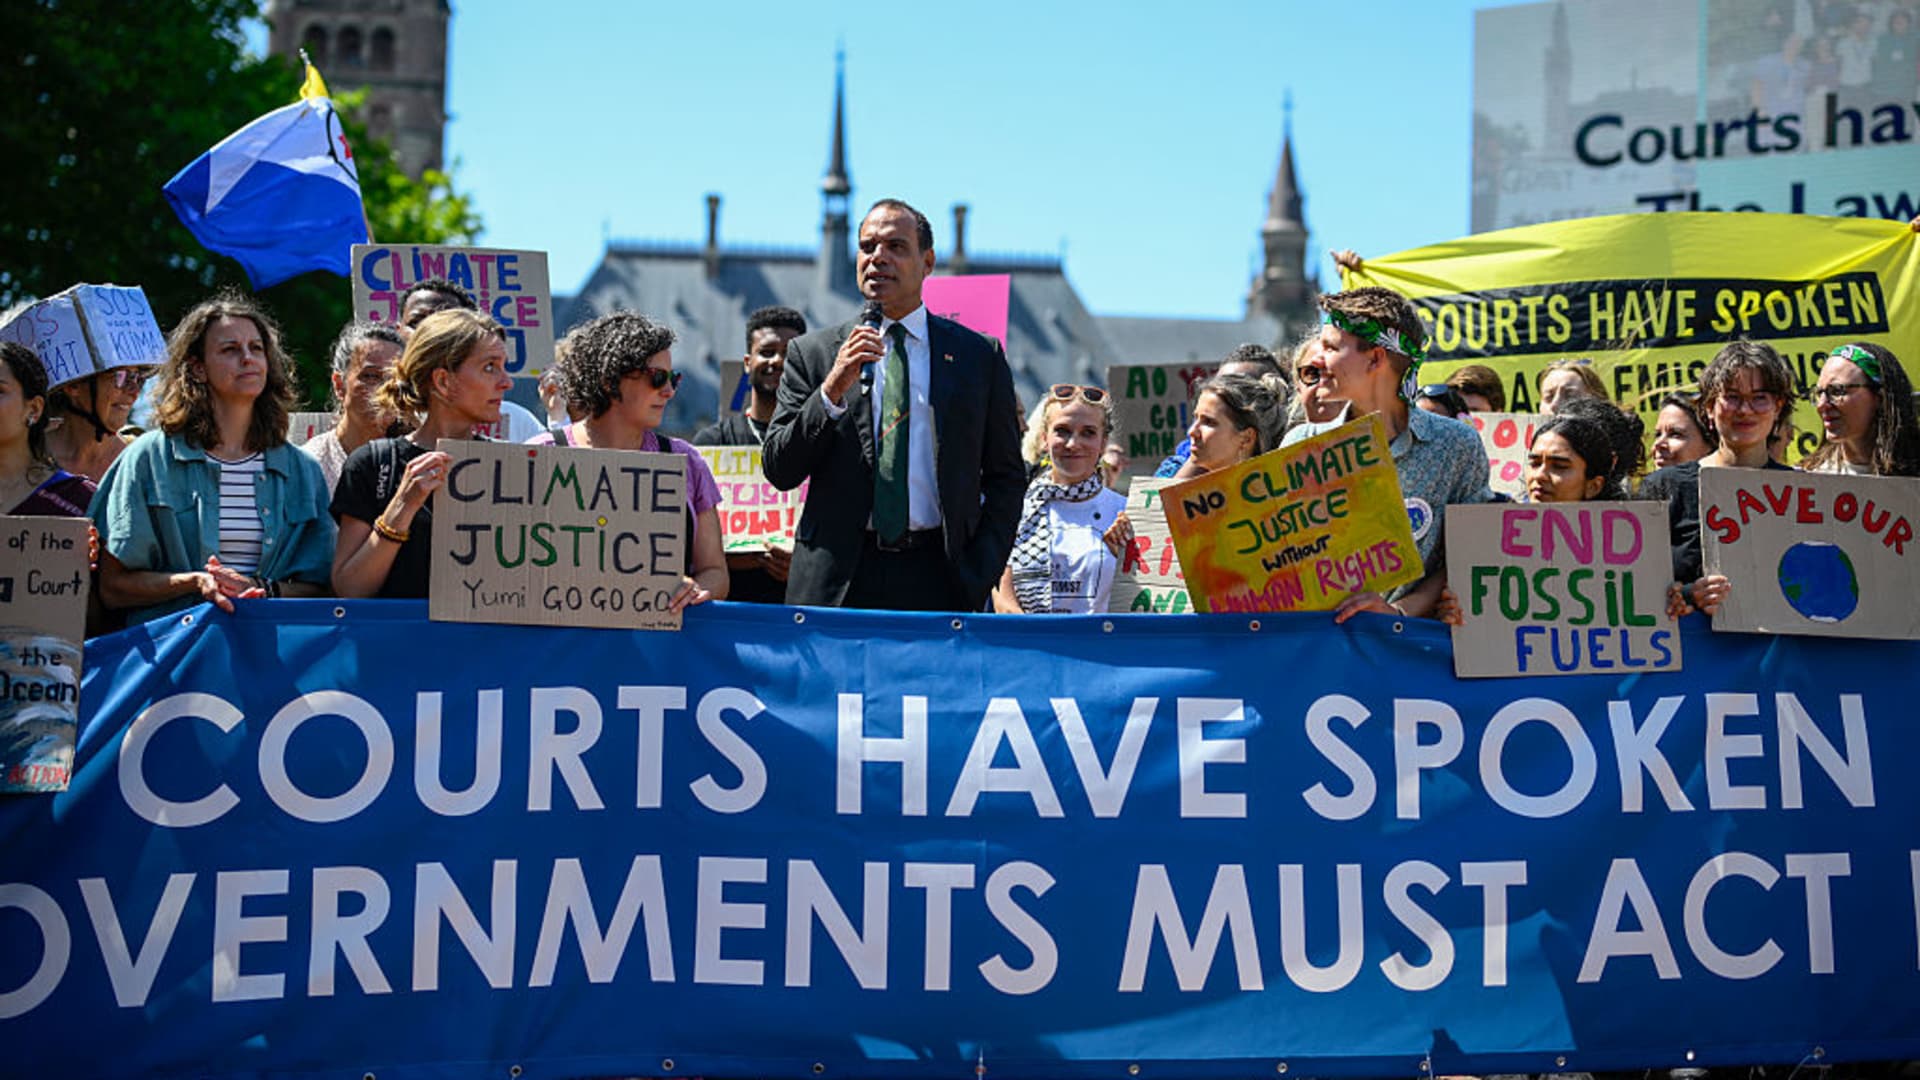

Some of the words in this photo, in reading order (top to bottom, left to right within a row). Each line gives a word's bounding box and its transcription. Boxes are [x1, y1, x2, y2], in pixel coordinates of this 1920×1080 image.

[1574, 107, 1801, 167] Courts
[1825, 92, 1920, 147] ha
[16, 303, 59, 348] OS
[95, 287, 145, 316] SOS
[1589, 289, 1696, 340] HAVE
[1711, 281, 1880, 333] SPOKEN
[1183, 490, 1226, 520] NO
[1240, 434, 1381, 504] CLIMATE
[8, 529, 30, 552] of
[41, 531, 74, 550] the
[1227, 488, 1349, 554] JUSTICE
[1501, 509, 1643, 565] END
[1706, 483, 1823, 544] SAVE
[1833, 491, 1913, 556] OUR
[1261, 534, 1332, 573] WITHOUT
[28, 569, 83, 596] Court
[463, 578, 526, 609] Yumi
[18, 646, 62, 667] the
[1515, 626, 1673, 672] FUELS
[119, 686, 768, 827] COURTS
[837, 693, 1247, 818] HAVE
[1302, 693, 1876, 820] SPOKEN
[1118, 861, 1528, 992] MUST
[1577, 852, 1851, 983] ACT
